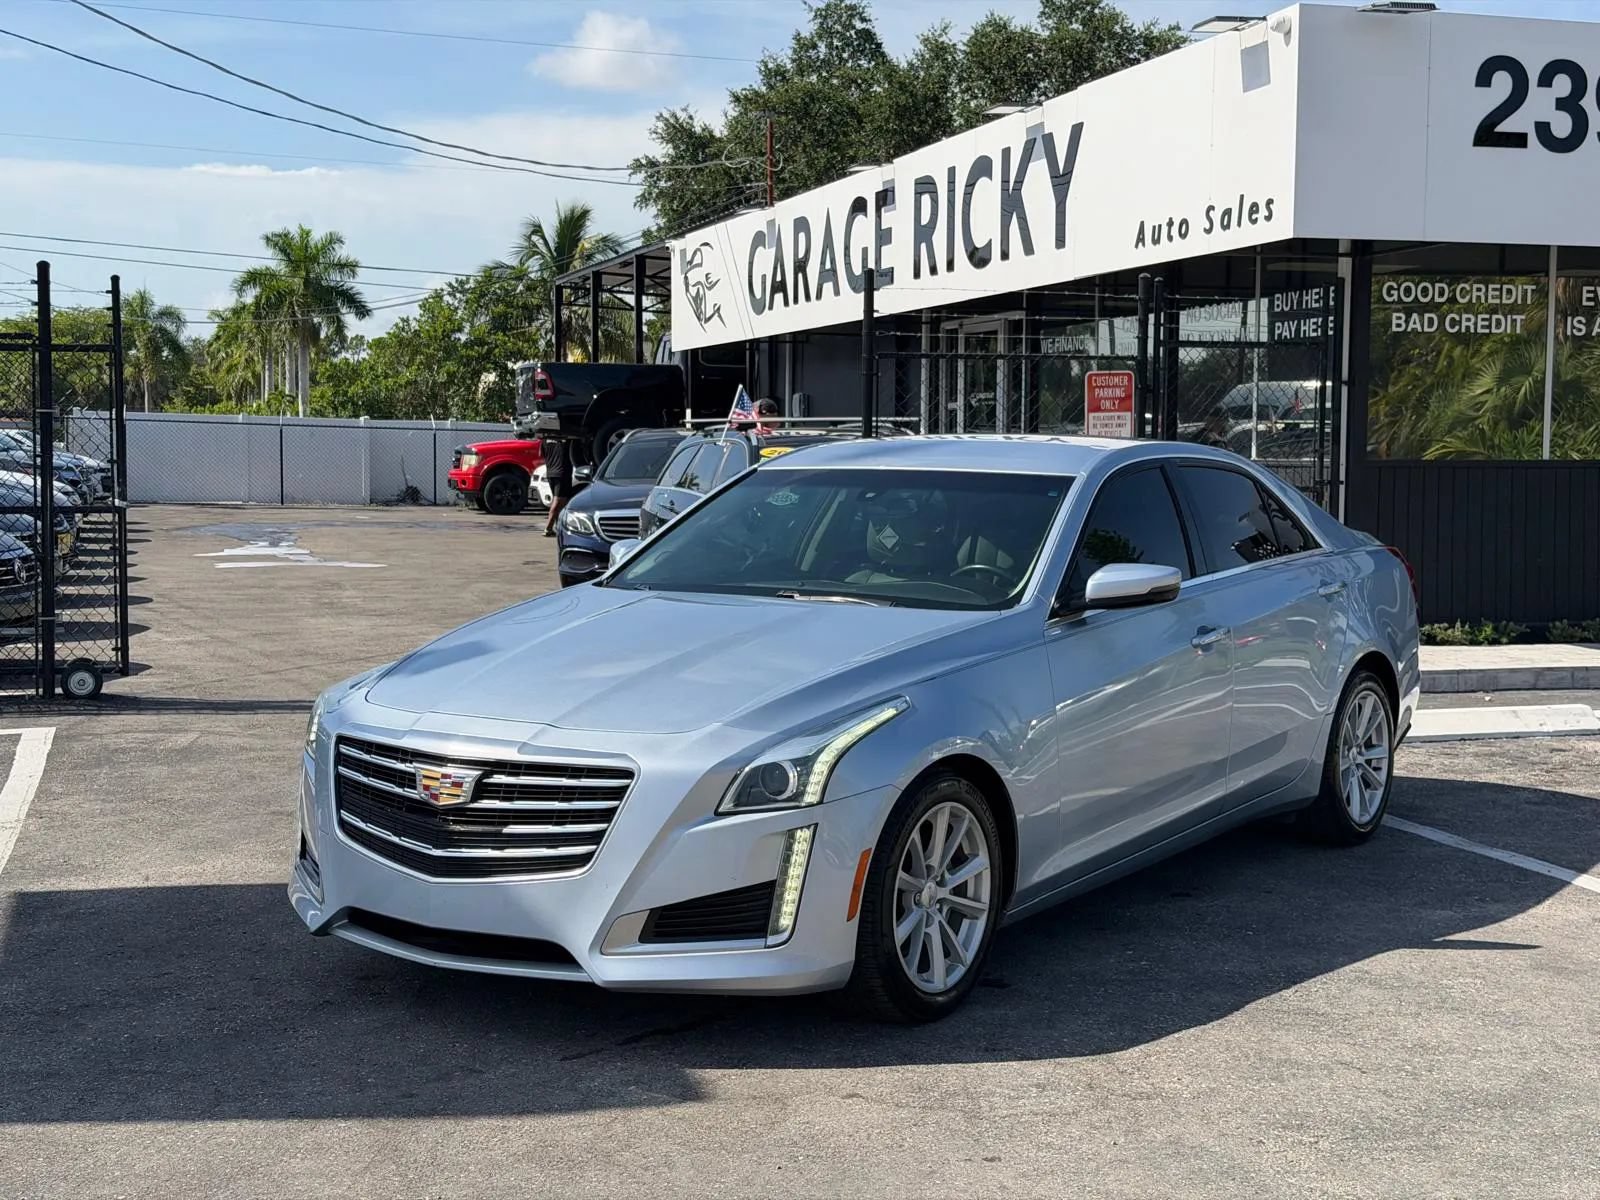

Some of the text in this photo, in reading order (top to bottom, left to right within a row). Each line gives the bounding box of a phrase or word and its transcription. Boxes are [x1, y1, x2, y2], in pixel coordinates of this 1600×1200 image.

[1472, 54, 1600, 154] 23
[748, 121, 1084, 316] GARAGE RICKY
[1134, 195, 1276, 249] Auto Sales
[1274, 290, 1299, 312] BUY
[1382, 281, 1537, 305] GOOD CREDIT
[1274, 319, 1297, 341] PAY
[1391, 312, 1526, 334] BAD CREDIT
[1566, 316, 1586, 337] IS
[1040, 339, 1053, 354] WE
[1092, 375, 1129, 387] CUSTOMER
[1094, 387, 1126, 399] PARKING
[1100, 399, 1120, 410] ONLY
